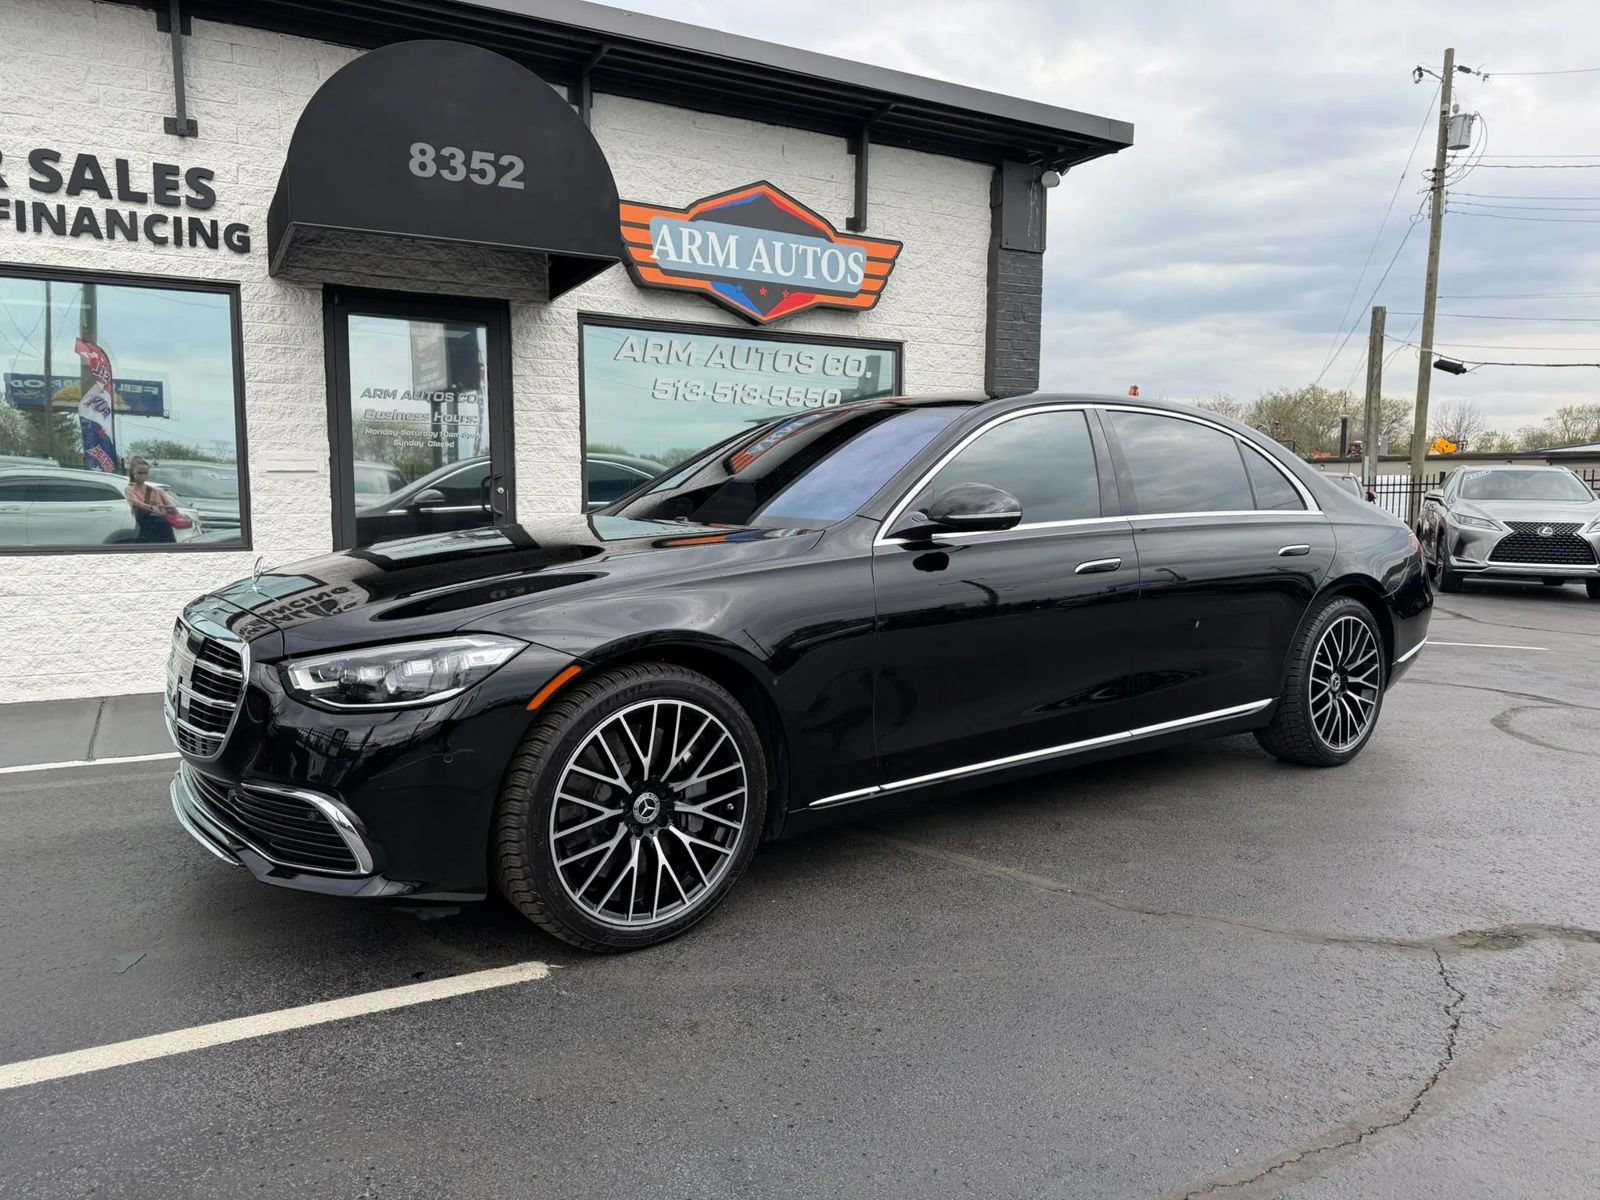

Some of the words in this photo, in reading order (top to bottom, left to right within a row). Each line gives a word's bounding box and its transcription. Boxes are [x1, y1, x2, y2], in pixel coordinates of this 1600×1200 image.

[28, 148, 217, 210] SALES
[408, 142, 525, 190] 8352
[650, 223, 740, 271] ARM
[746, 236, 866, 286] AUTOS
[613, 336, 695, 367] ARM
[704, 341, 818, 376] AUTOS
[822, 352, 874, 379] CO.
[360, 387, 398, 400] ARM
[400, 390, 455, 403] AUTOS
[364, 408, 431, 421] Business
[651, 378, 843, 409] 513-513-5550
